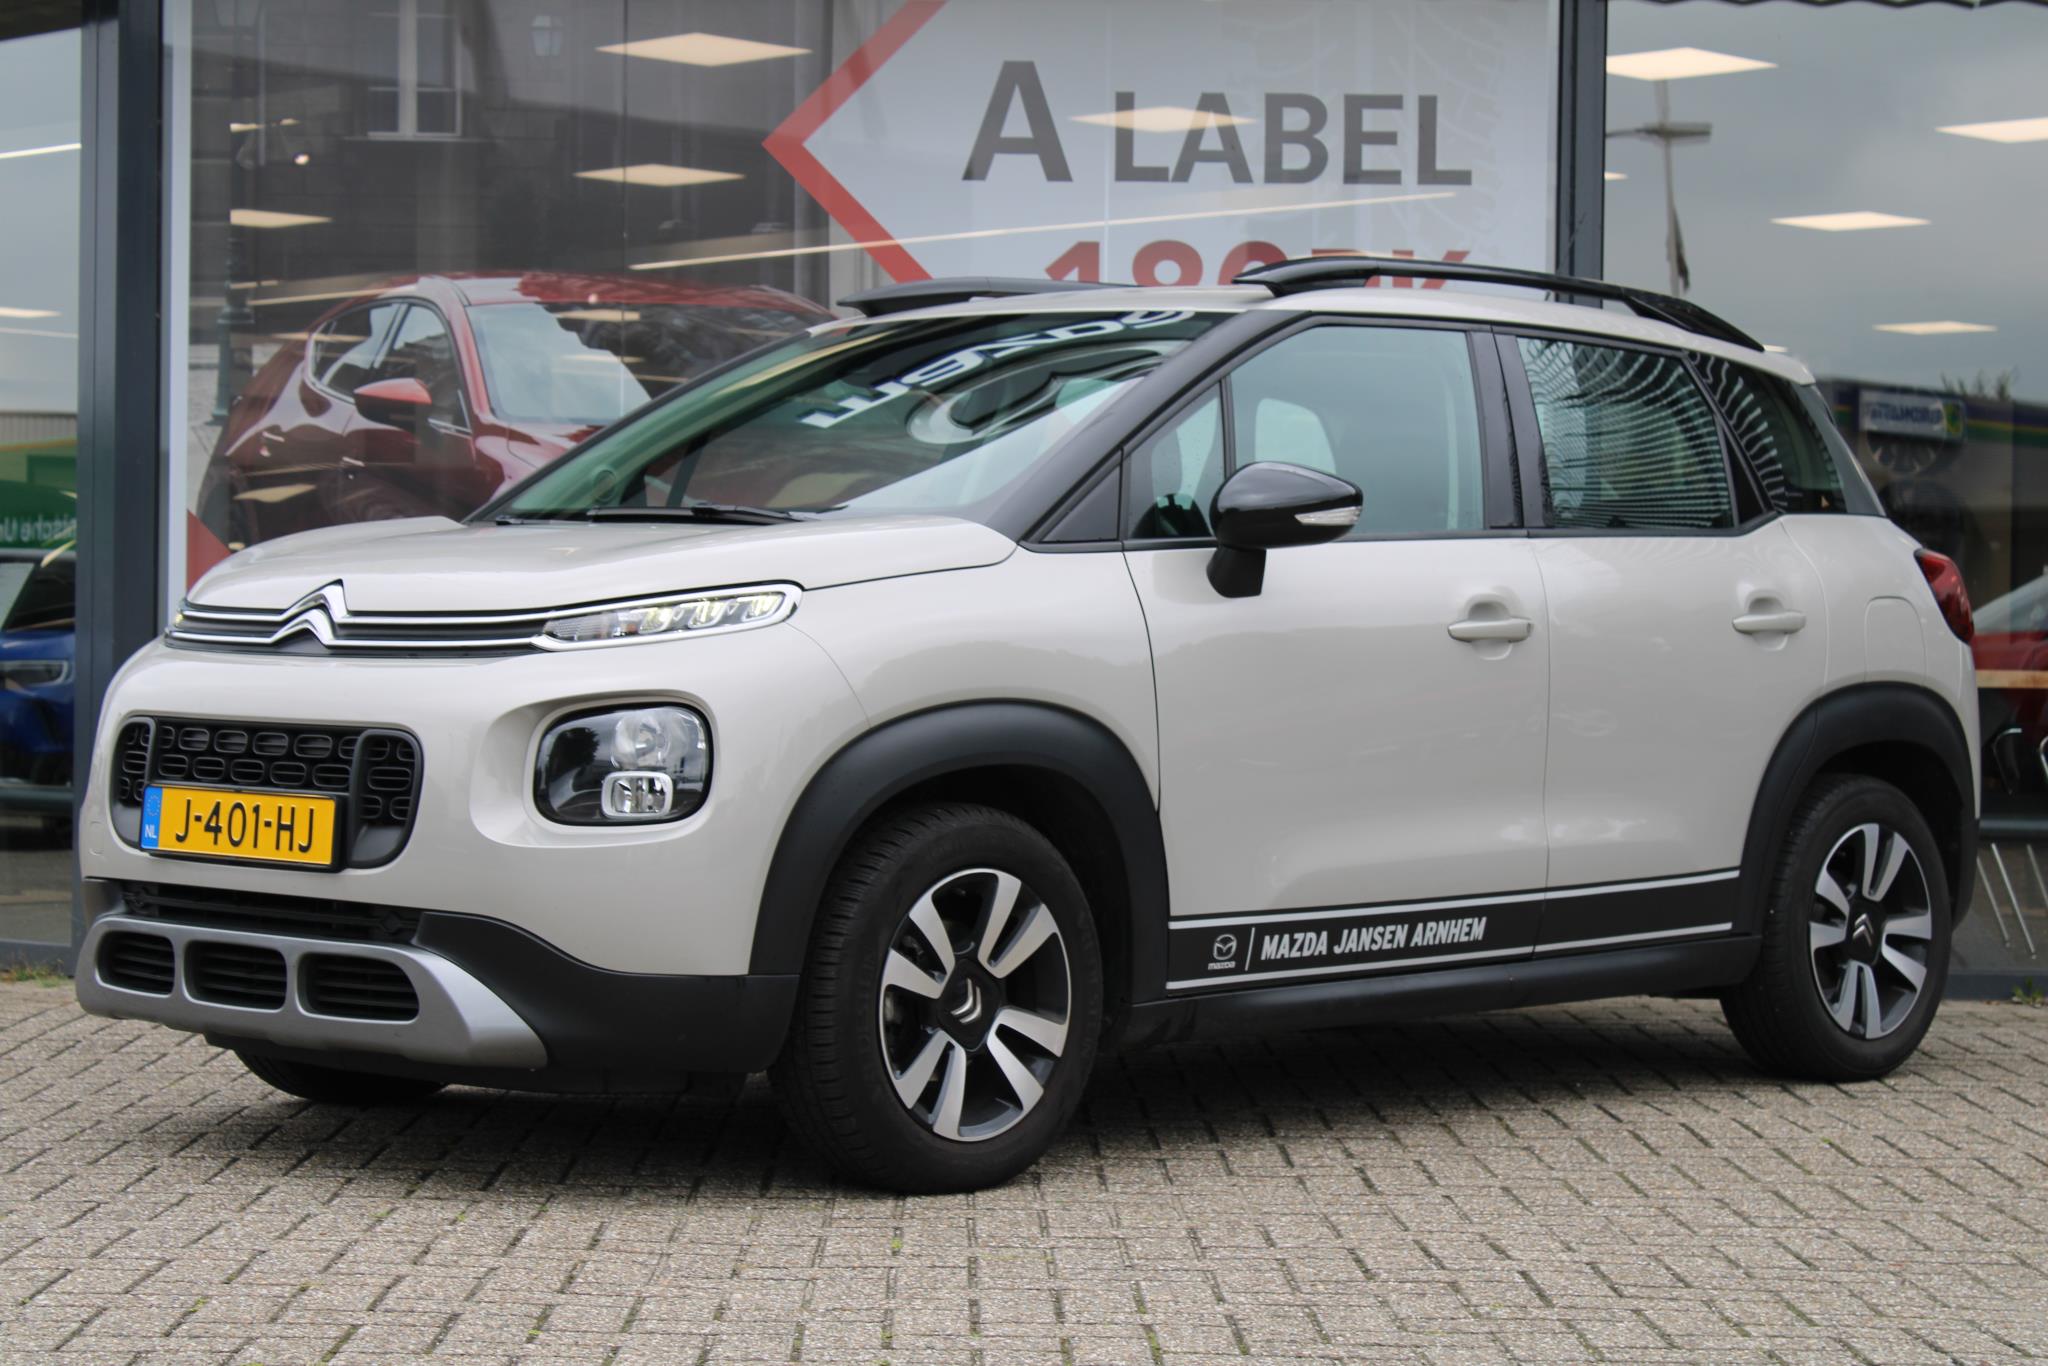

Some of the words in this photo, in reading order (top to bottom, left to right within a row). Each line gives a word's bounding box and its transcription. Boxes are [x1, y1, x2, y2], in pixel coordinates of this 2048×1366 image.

[961, 60, 1073, 182] A
[1115, 91, 1473, 186] LABEL
[144, 824, 158, 839] NL
[175, 799, 314, 853] J-401-HJ
[1260, 930, 1329, 961] MAZDA
[1333, 924, 1409, 955] JANSEN
[1410, 916, 1488, 948] ARNHEM
